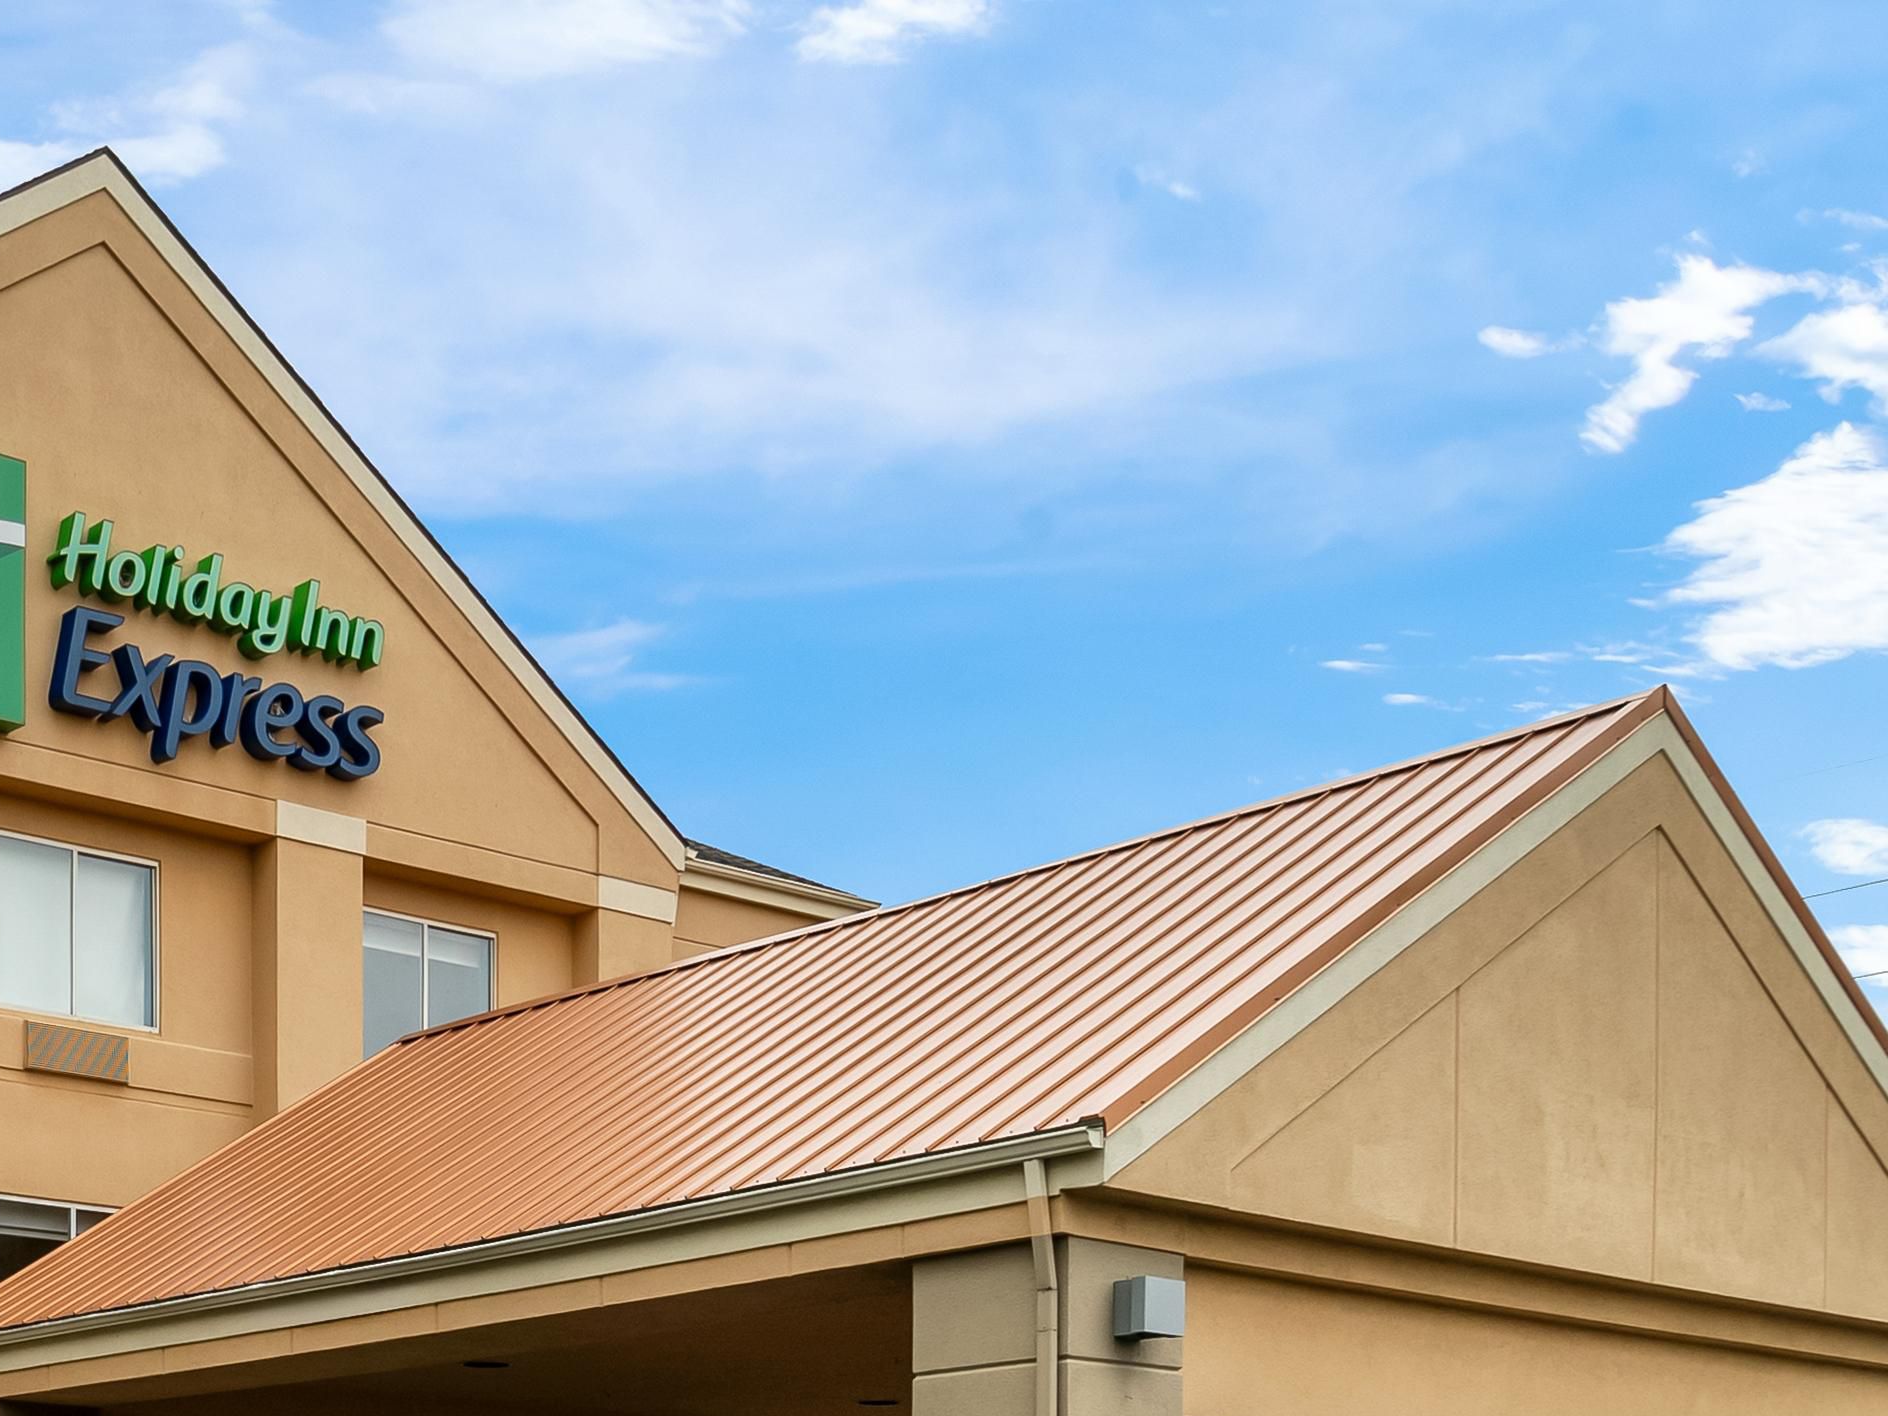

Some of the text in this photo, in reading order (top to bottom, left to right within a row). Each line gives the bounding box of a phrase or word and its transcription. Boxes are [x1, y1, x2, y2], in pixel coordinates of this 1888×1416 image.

[48, 511, 385, 672] Holiday Inn
[48, 604, 385, 781] Express
